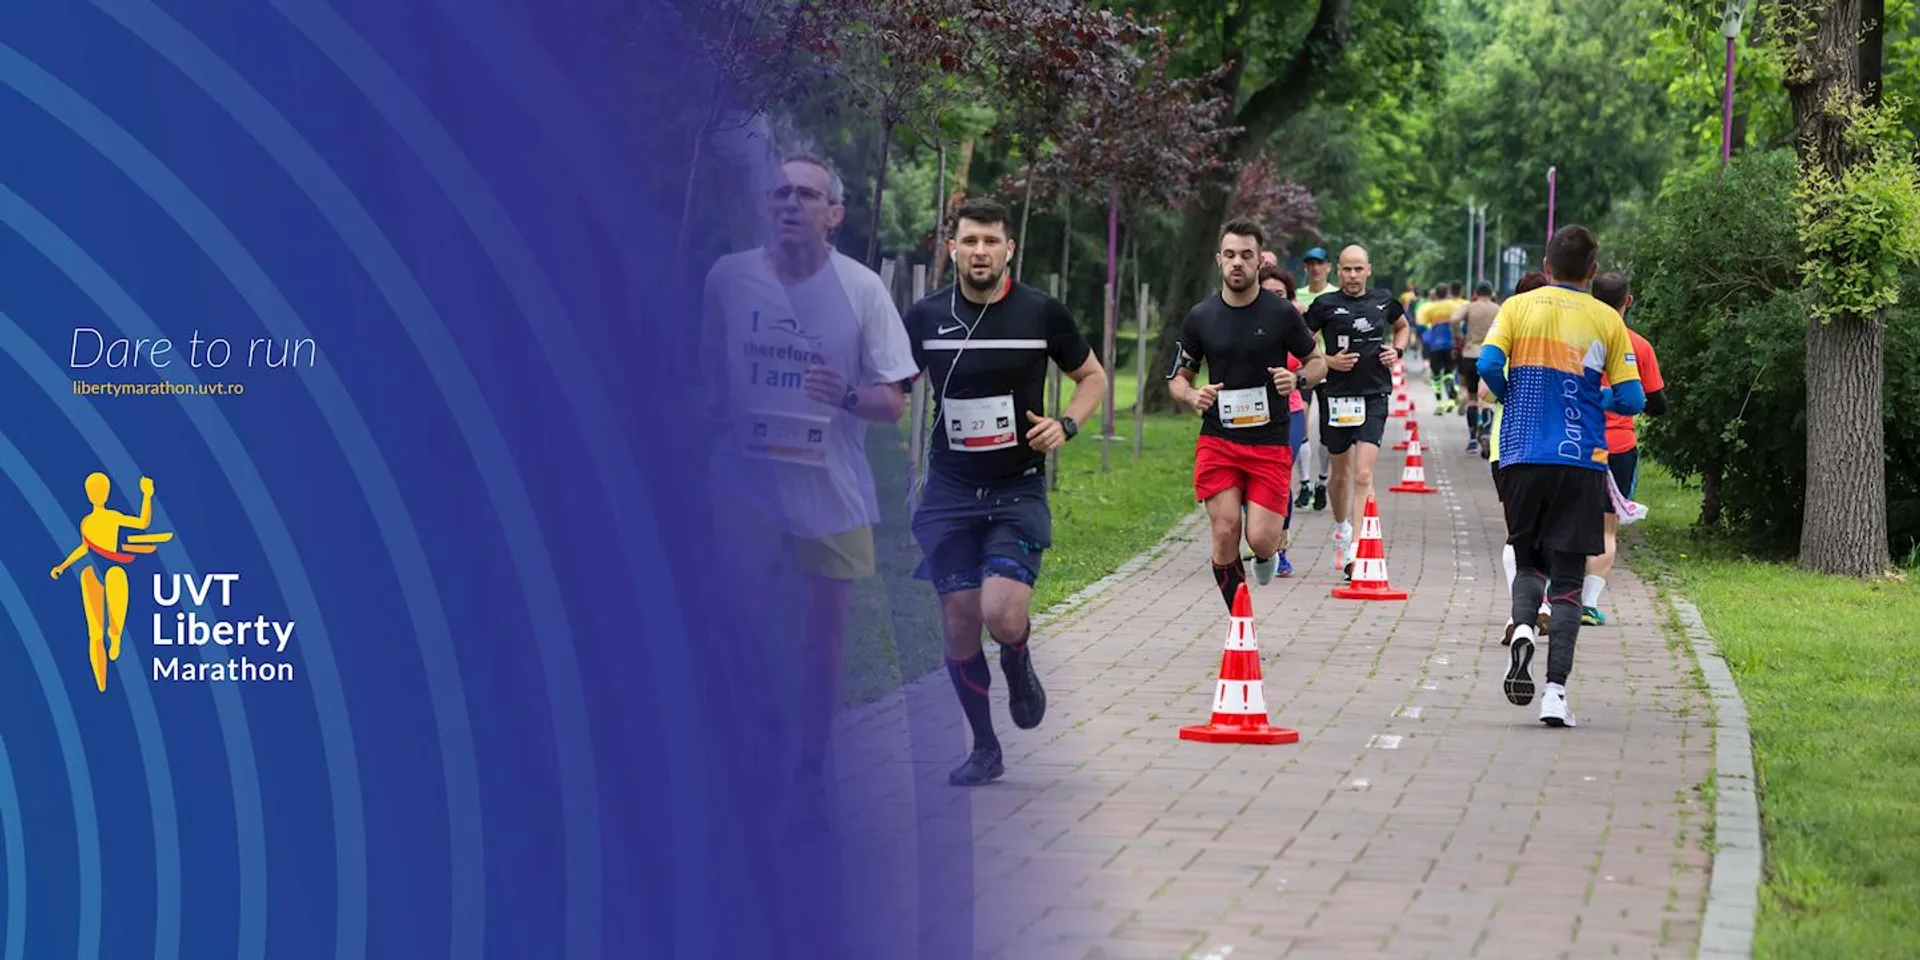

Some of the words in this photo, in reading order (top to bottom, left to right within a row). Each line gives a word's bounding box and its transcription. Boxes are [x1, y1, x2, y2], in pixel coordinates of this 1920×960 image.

[766, 370, 803, 389] am
[972, 420, 985, 431] 27
[1558, 407, 1582, 460] Dare
